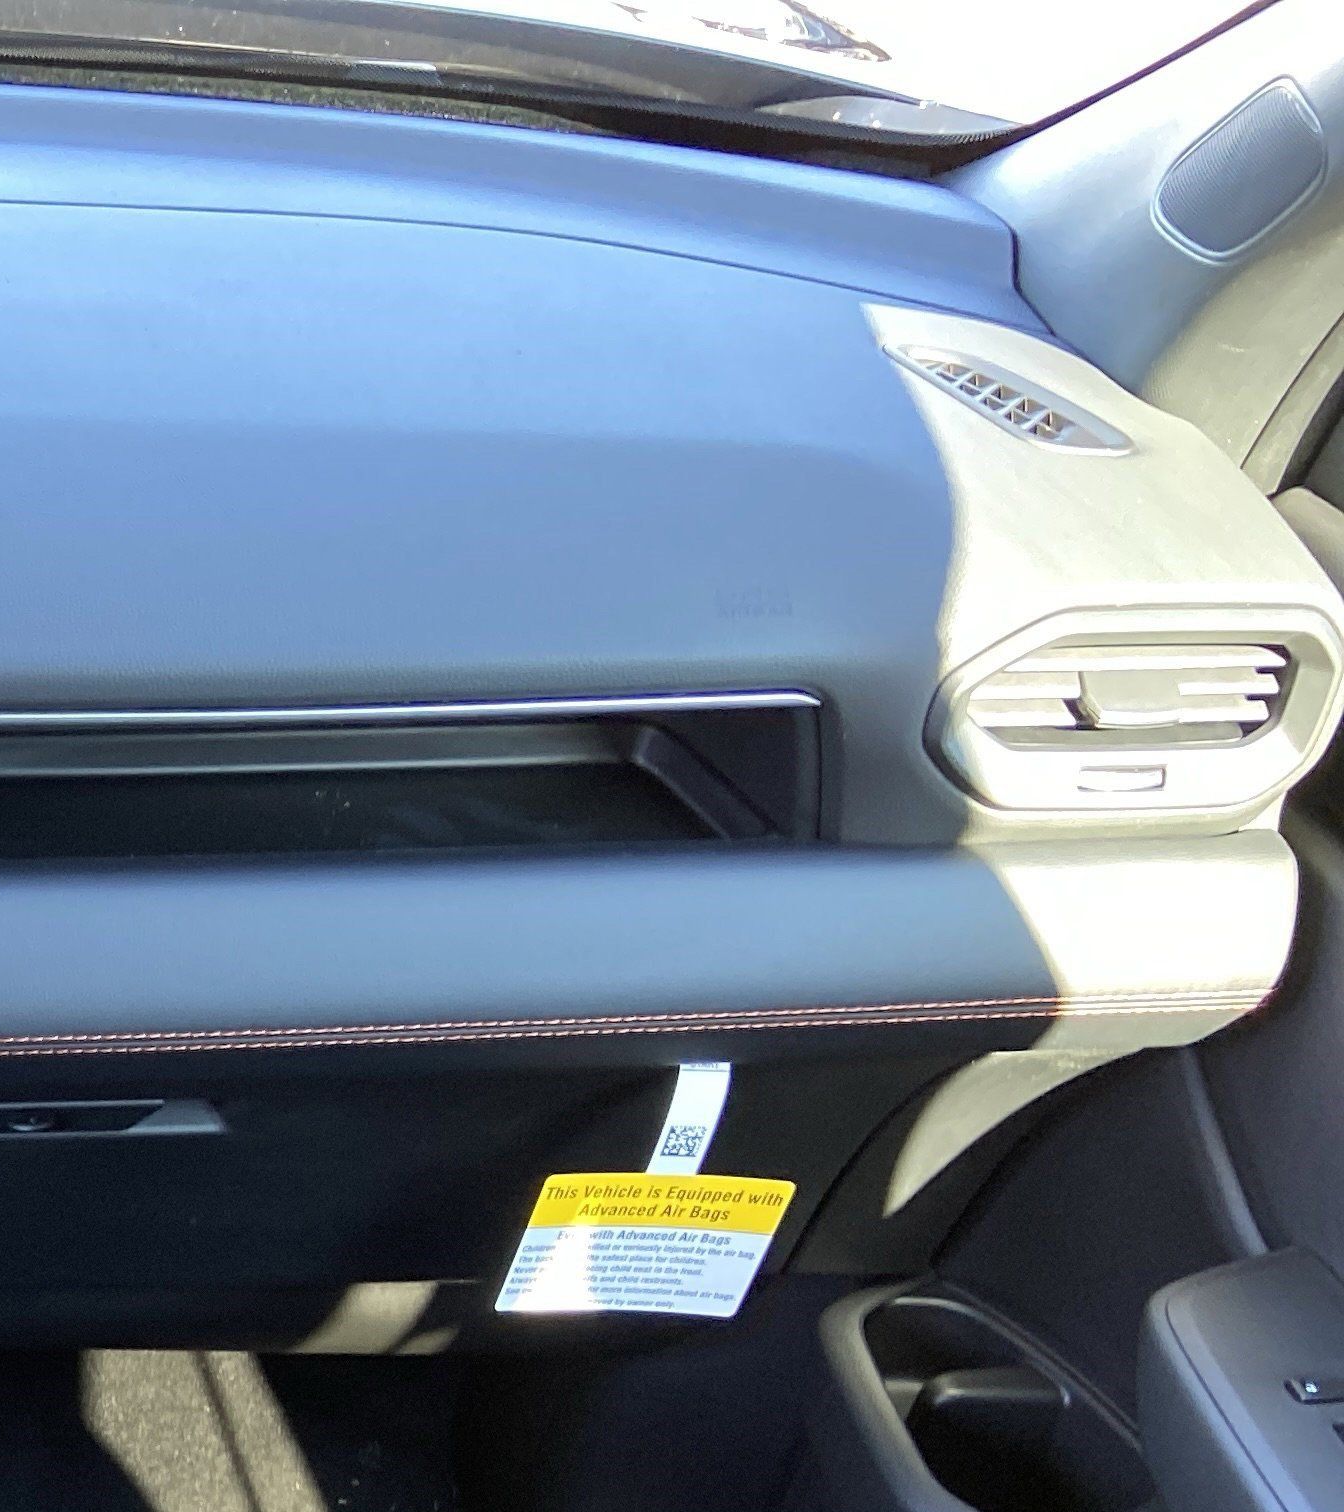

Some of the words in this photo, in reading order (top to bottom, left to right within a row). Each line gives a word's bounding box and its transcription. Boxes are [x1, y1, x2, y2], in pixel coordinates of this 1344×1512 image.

[546, 1185, 578, 1200] This
[584, 1185, 642, 1199] Vehicle
[647, 1185, 662, 1198] is
[666, 1186, 745, 1204] Equipped
[749, 1191, 784, 1207] with
[578, 1203, 658, 1217] Advanced
[661, 1204, 687, 1218] Air
[689, 1206, 730, 1223] Bags
[590, 1230, 615, 1240] with
[616, 1230, 677, 1242] Advanced
[678, 1231, 698, 1242] Air
[700, 1233, 732, 1246] Bags
